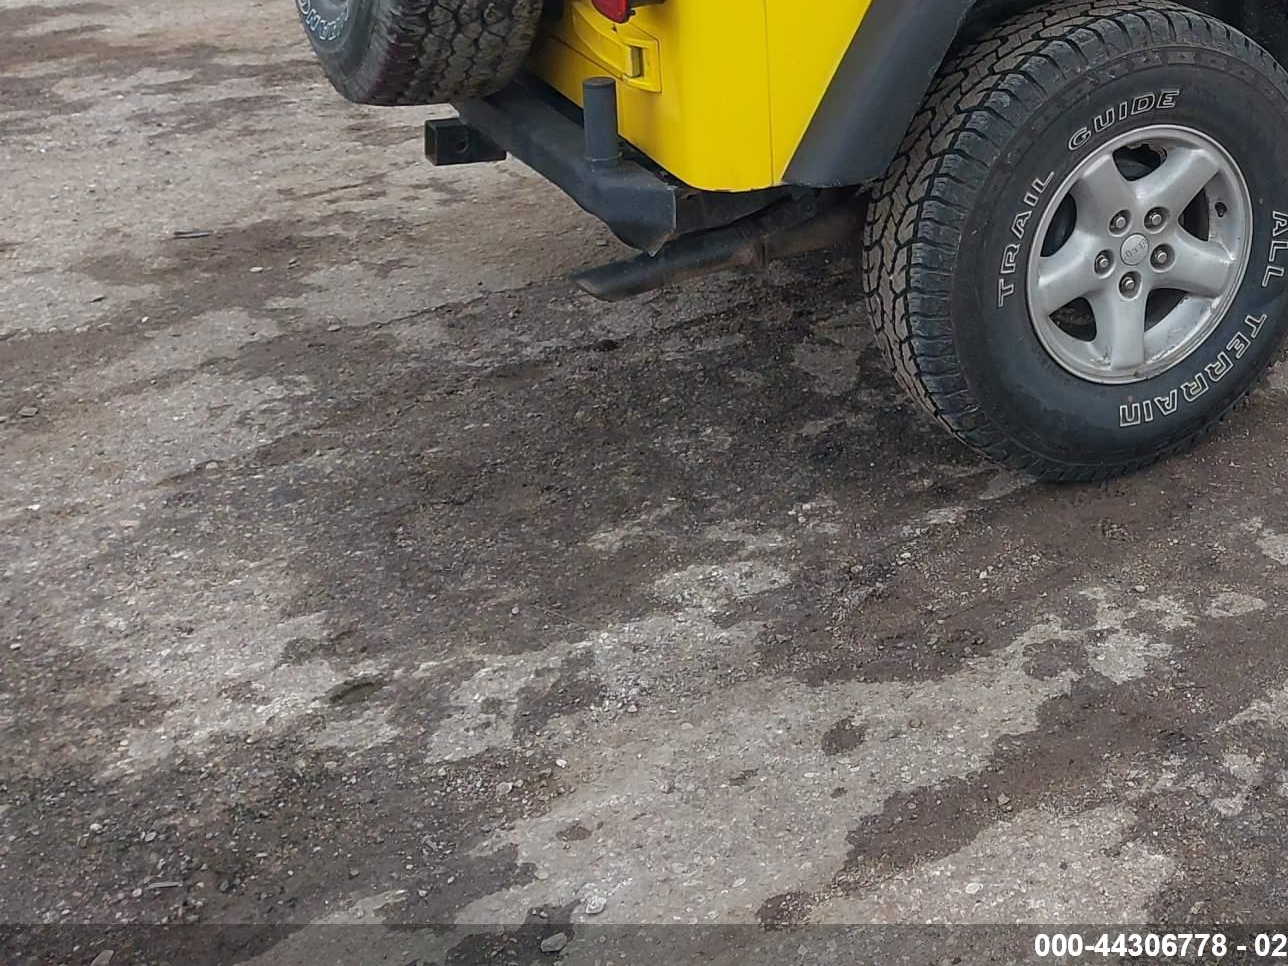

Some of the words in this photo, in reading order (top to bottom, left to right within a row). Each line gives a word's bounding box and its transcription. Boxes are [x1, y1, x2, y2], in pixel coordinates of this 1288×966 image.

[997, 170, 1055, 308] TRAIL
[1067, 88, 1181, 152] GUIDE
[1119, 312, 1268, 428] TERRAIN
